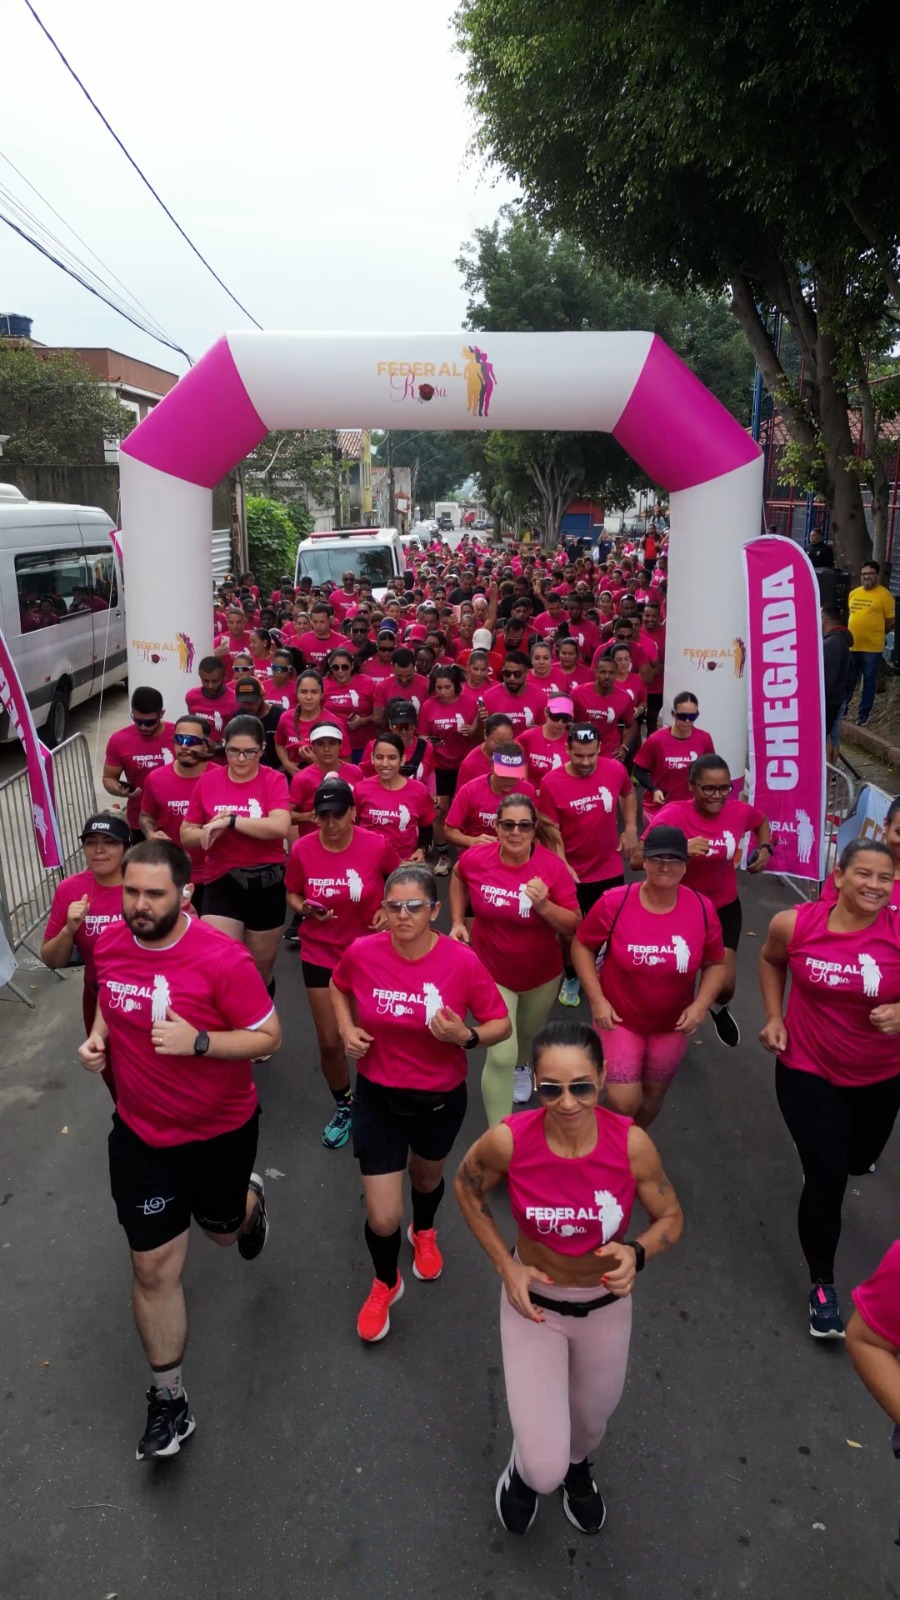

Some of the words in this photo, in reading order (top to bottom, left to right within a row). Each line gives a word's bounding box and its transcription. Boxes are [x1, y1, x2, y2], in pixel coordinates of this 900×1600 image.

[376, 361, 461, 377] FEDERAL
[132, 640, 178, 652] FEDERAL
[683, 648, 733, 658] FEDERAL
[761, 564, 799, 791] CHEGADA
[369, 809, 399, 817] FEDERAL
[308, 878, 348, 887] FEDERAL
[481, 885, 519, 899] FEDERAL
[627, 944, 674, 953] FEDERAL
[805, 956, 860, 974] FEDERAL
[373, 988, 424, 1004] FEDERAL
[526, 1207, 599, 1220] FEDERAL
